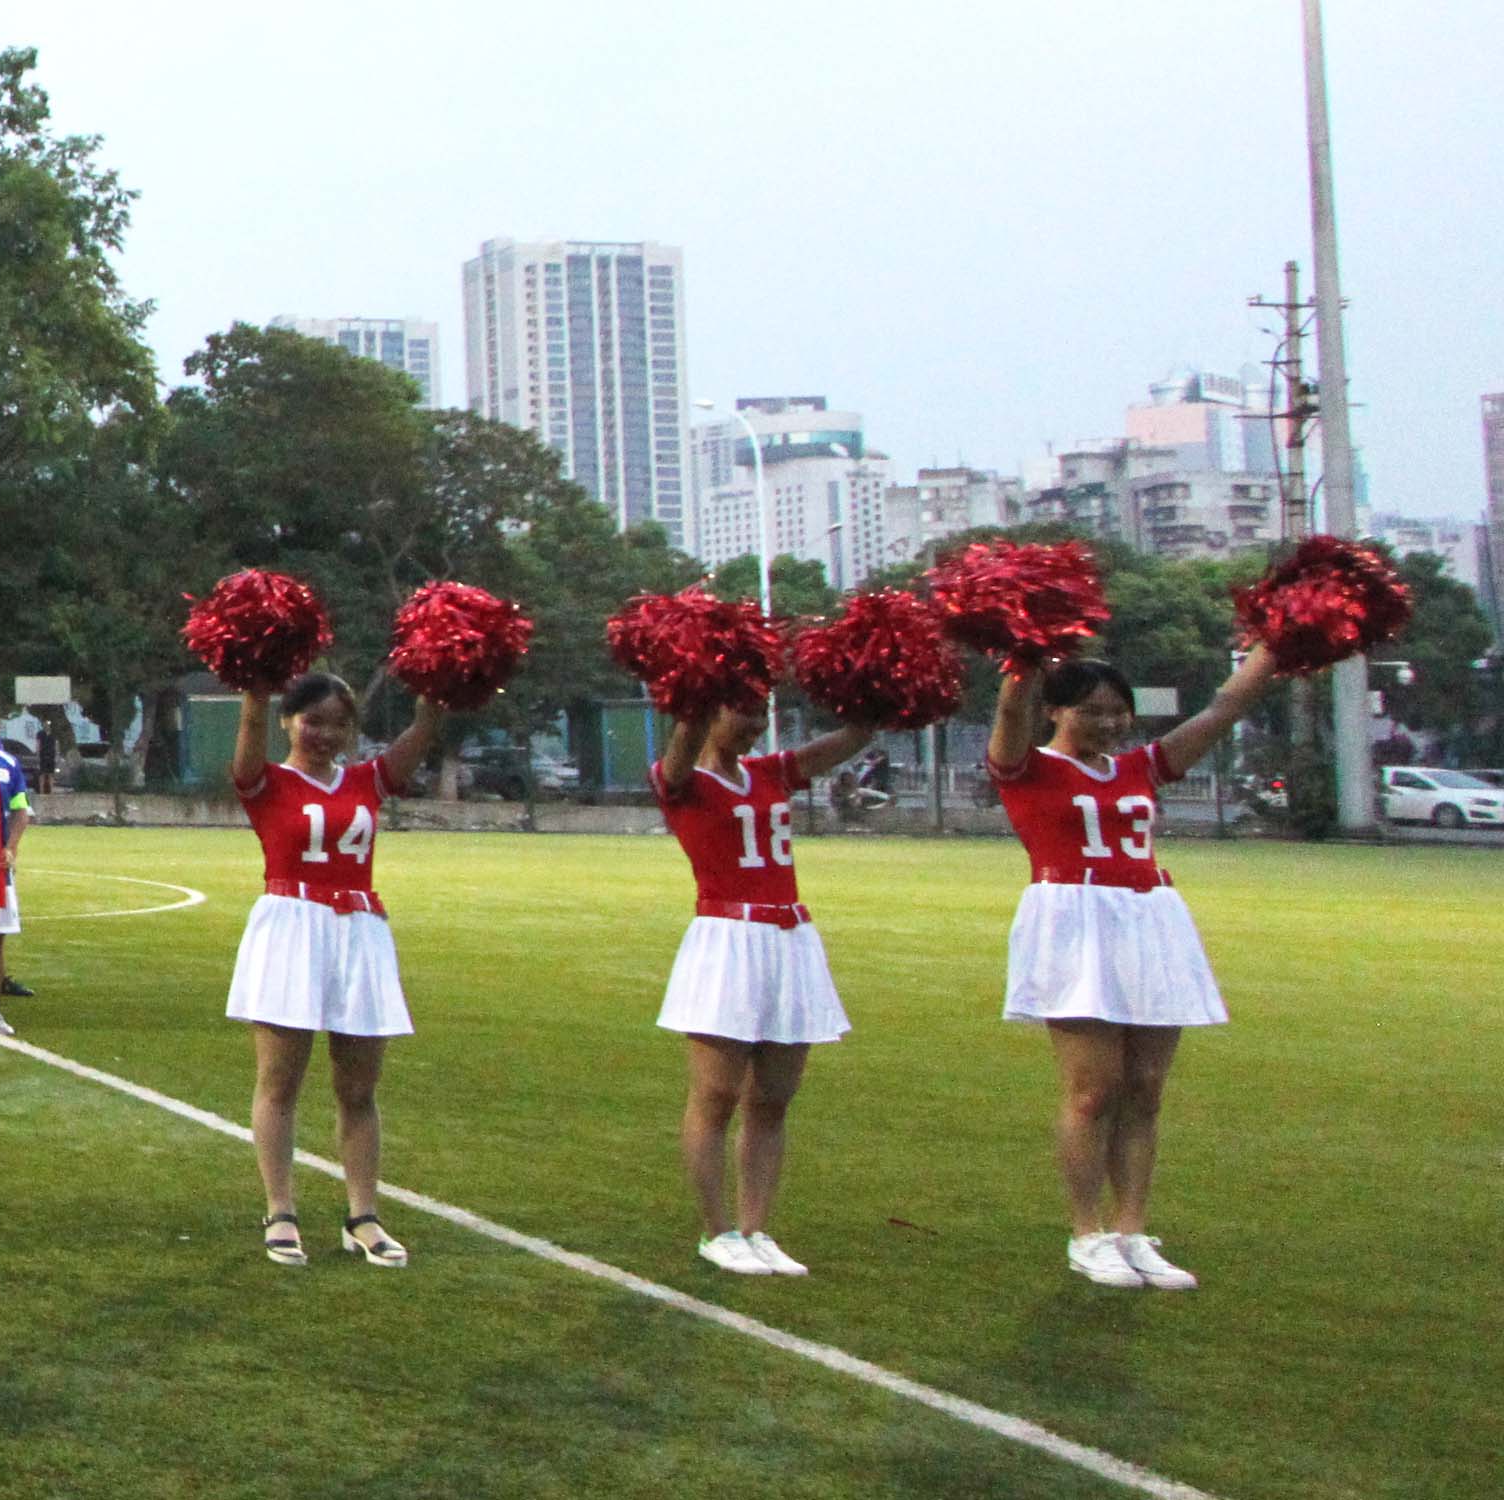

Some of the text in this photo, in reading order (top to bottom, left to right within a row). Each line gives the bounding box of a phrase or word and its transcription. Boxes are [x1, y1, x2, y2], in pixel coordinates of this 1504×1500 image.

[301, 803, 377, 864] 14
[732, 804, 795, 869] 18
[1072, 794, 1157, 861] 13
